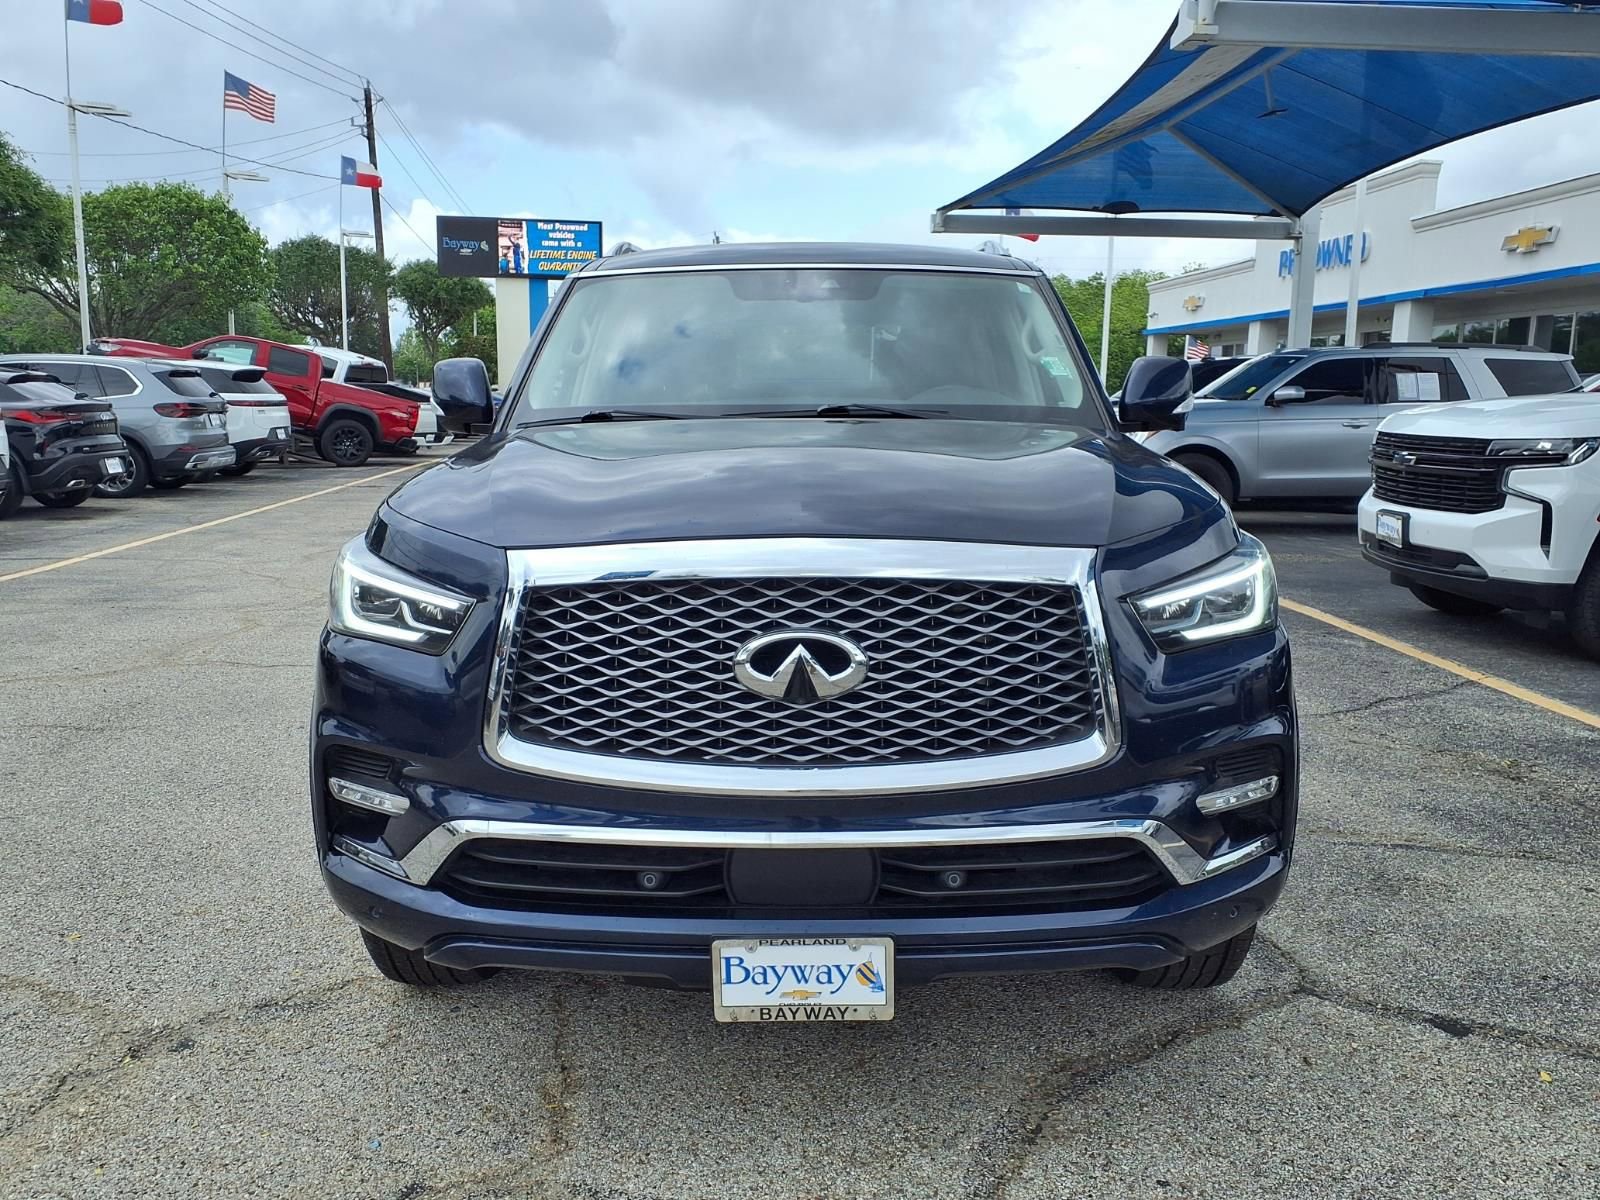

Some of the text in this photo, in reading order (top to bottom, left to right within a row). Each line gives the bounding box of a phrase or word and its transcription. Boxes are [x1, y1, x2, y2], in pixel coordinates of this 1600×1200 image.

[442, 237, 480, 252] Bayway
[530, 250, 597, 260] LIFETIME ENGINE
[722, 956, 856, 995] Bayway
[760, 1007, 850, 1021] BAYWAY
